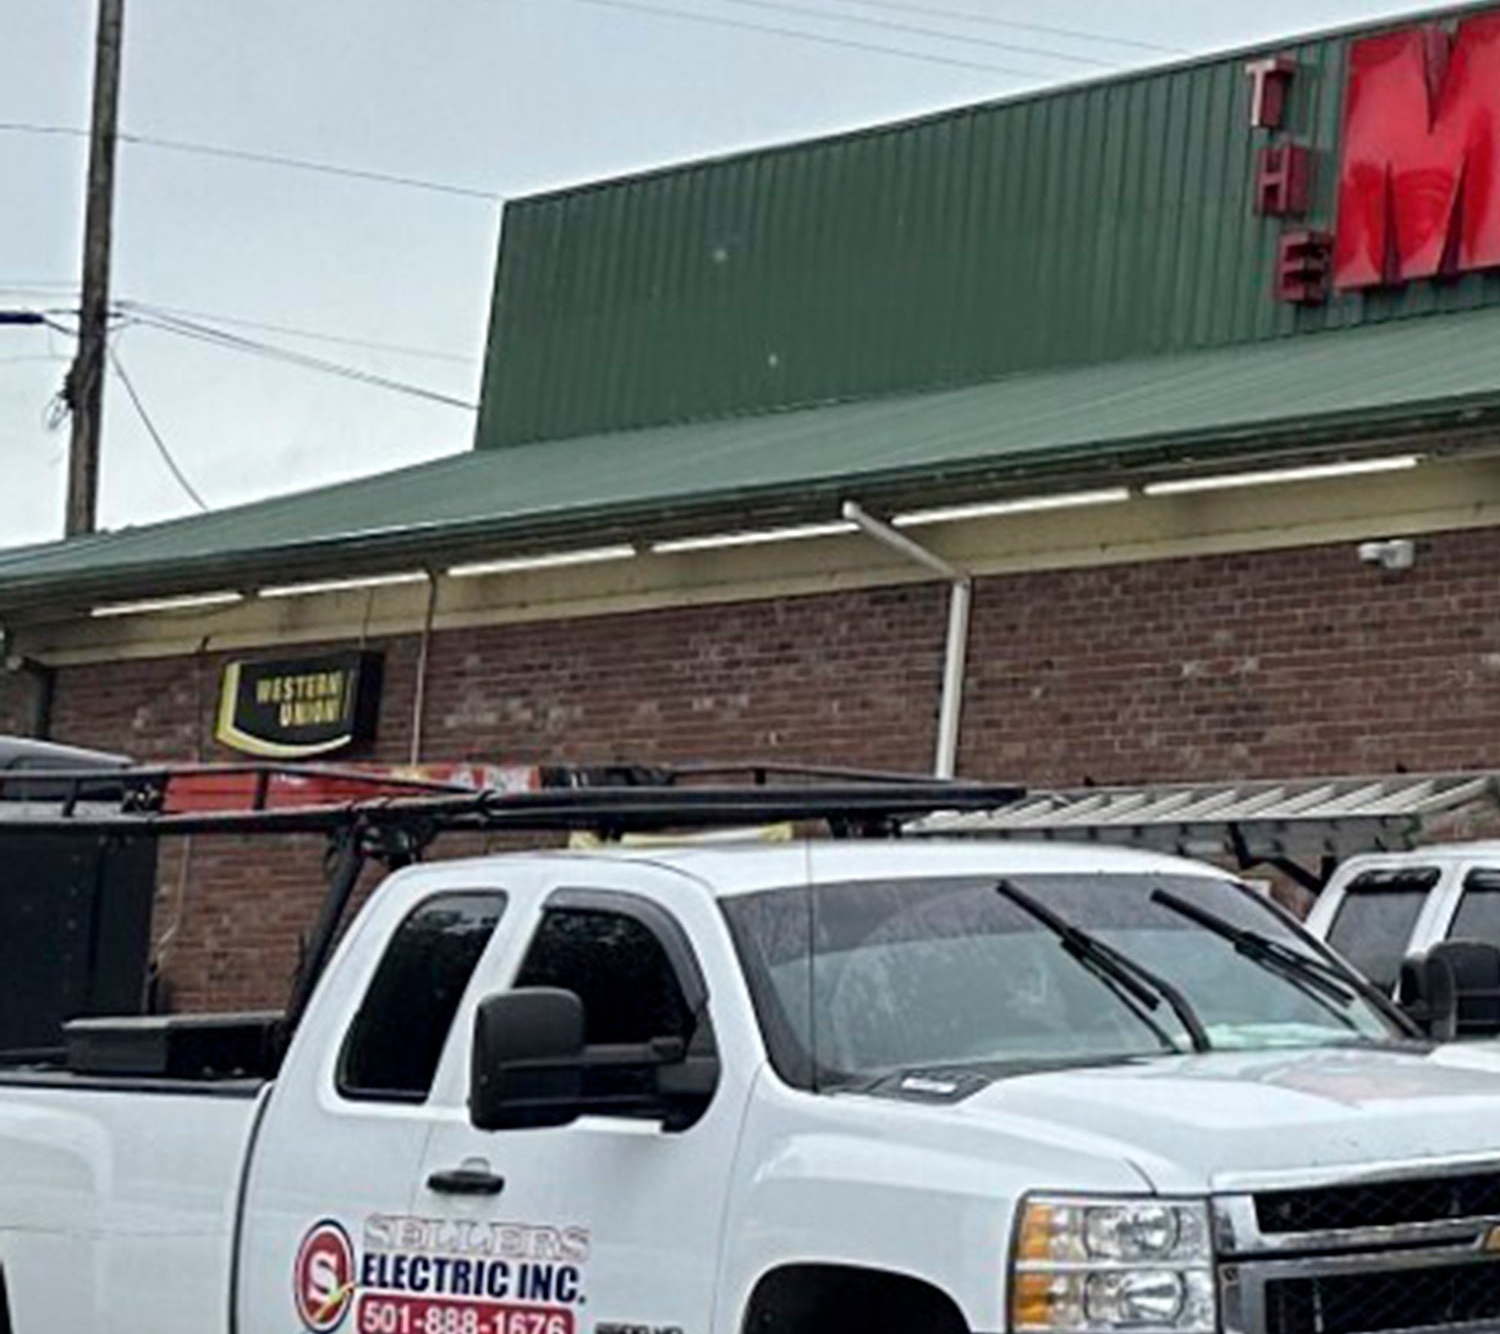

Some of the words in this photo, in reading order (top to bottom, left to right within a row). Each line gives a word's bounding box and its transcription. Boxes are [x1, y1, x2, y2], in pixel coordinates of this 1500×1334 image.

[1245, 56, 1332, 305] THE
[256, 670, 344, 704] WESTERN
[278, 698, 341, 728] UNION
[362, 1213, 593, 1263] SELLERS
[361, 1253, 511, 1300] ELECTRIC
[516, 1263, 587, 1306] INC.
